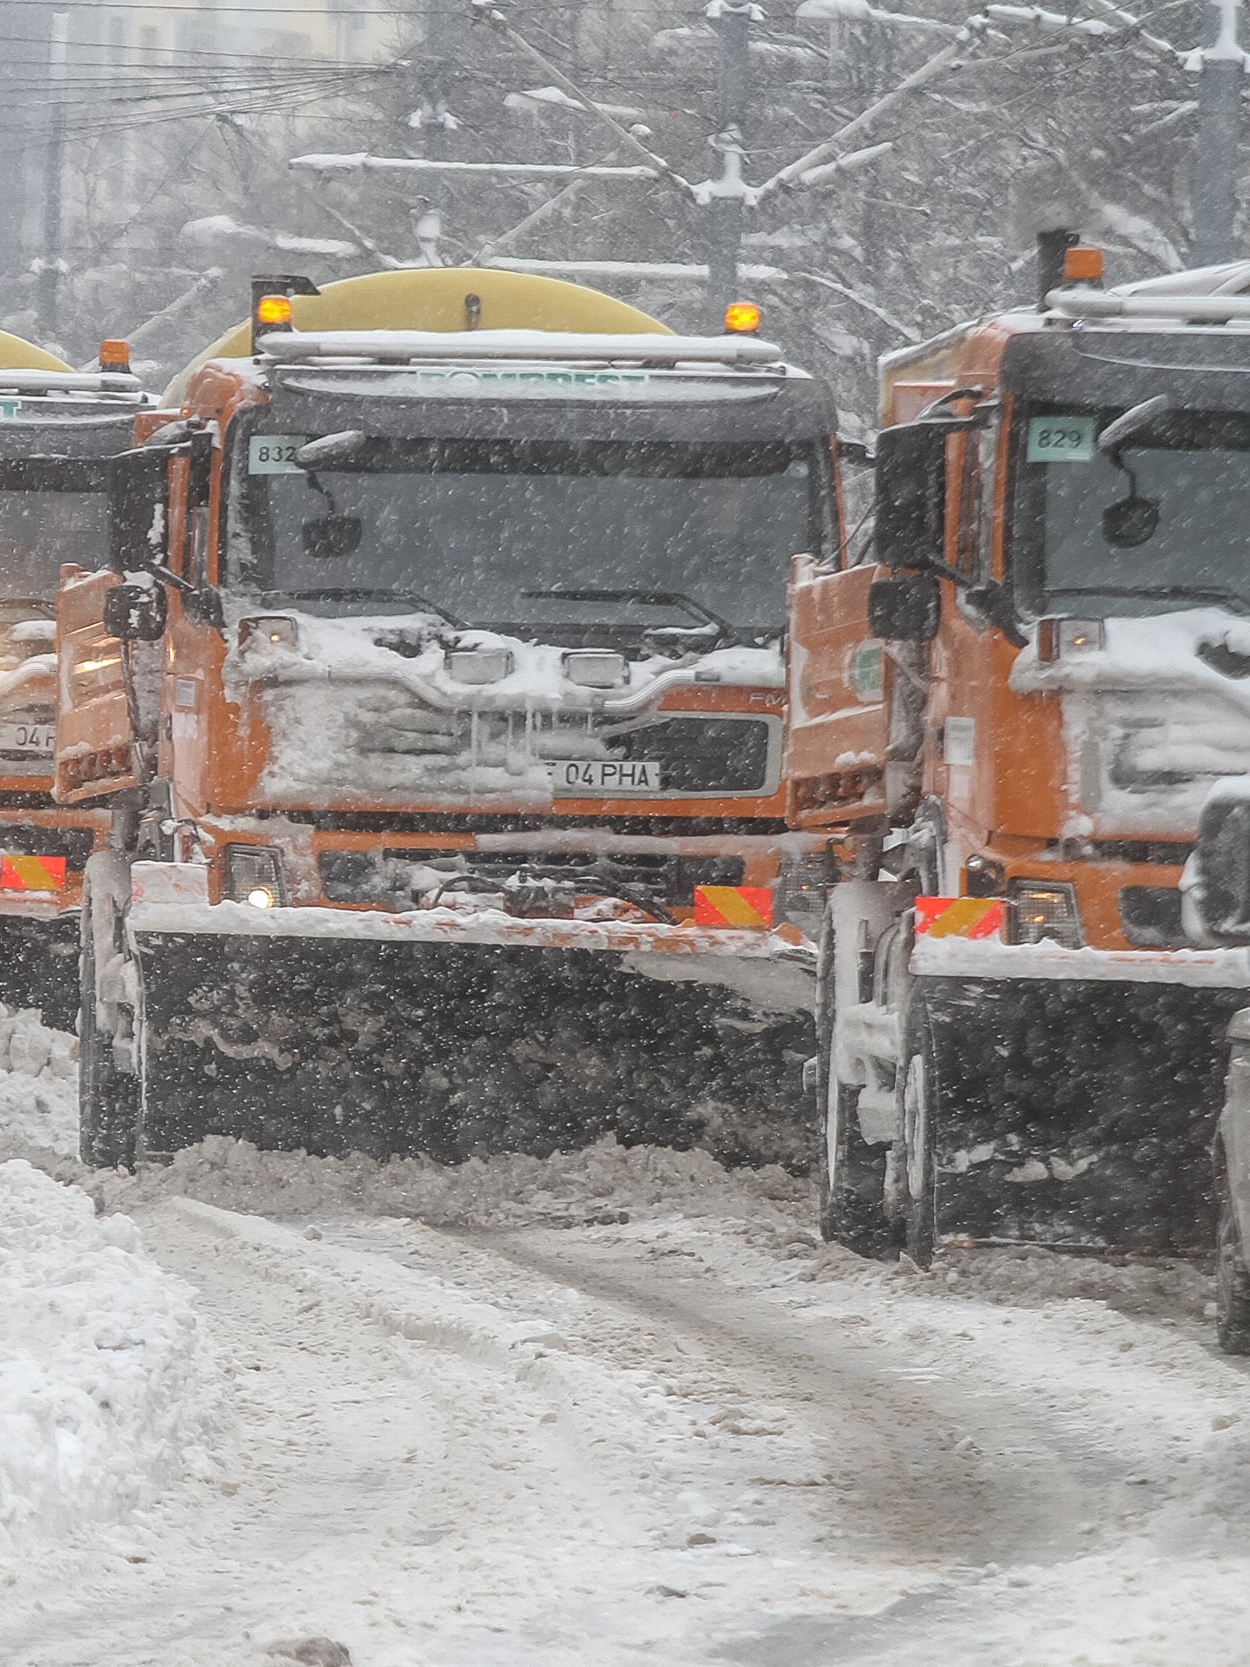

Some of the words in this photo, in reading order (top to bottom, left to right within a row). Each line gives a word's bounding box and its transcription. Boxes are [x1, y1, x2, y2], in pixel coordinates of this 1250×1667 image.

[1037, 429, 1082, 448] 829
[258, 446, 296, 462] 832
[15, 726, 41, 747] 04
[565, 763, 594, 785] 04
[600, 764, 650, 786] PHA
